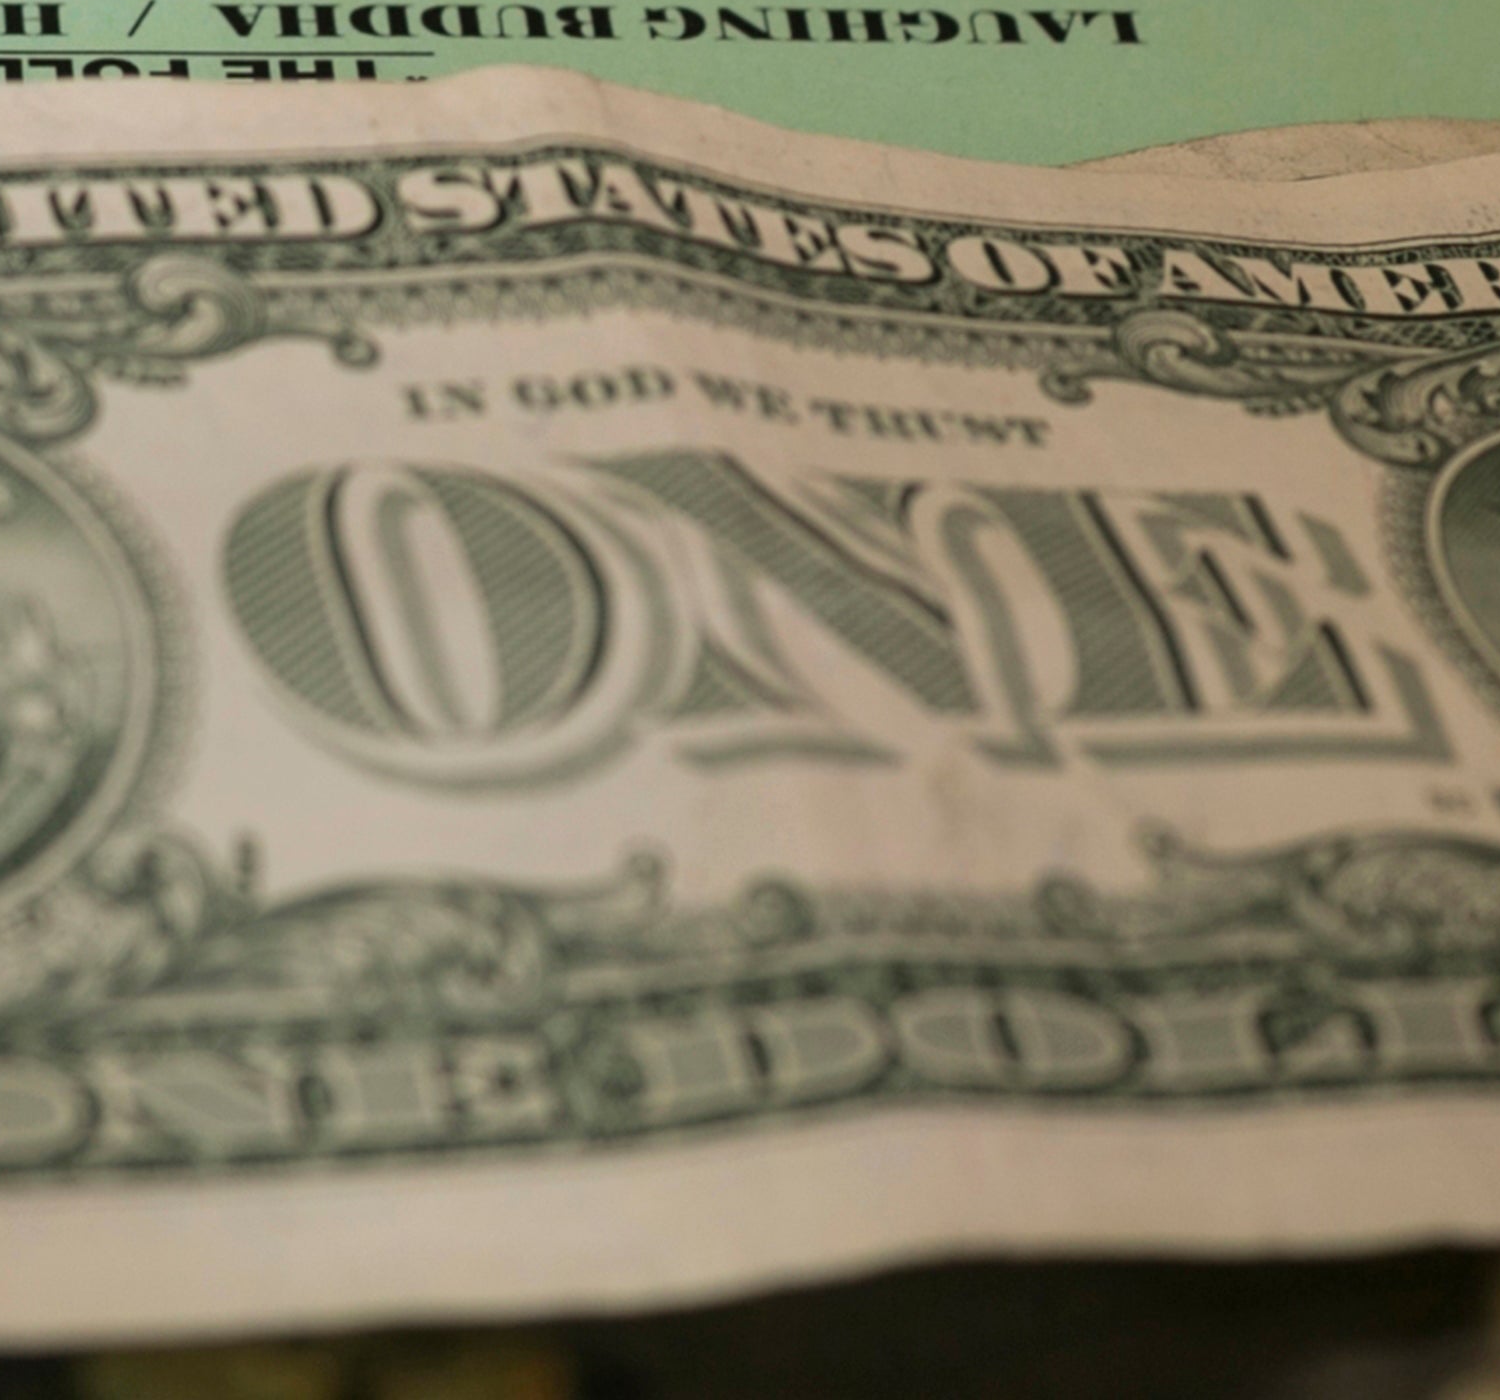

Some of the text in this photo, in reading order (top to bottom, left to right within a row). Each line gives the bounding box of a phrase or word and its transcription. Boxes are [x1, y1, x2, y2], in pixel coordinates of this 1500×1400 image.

[208, 0, 620, 42] BUDDHA
[641, 2, 1147, 47] LAUGHING
[398, 160, 944, 288] STATES
[944, 234, 1136, 299] OF
[402, 364, 1055, 453] IN GOD WE TRUST
[218, 448, 1458, 796] ONE
